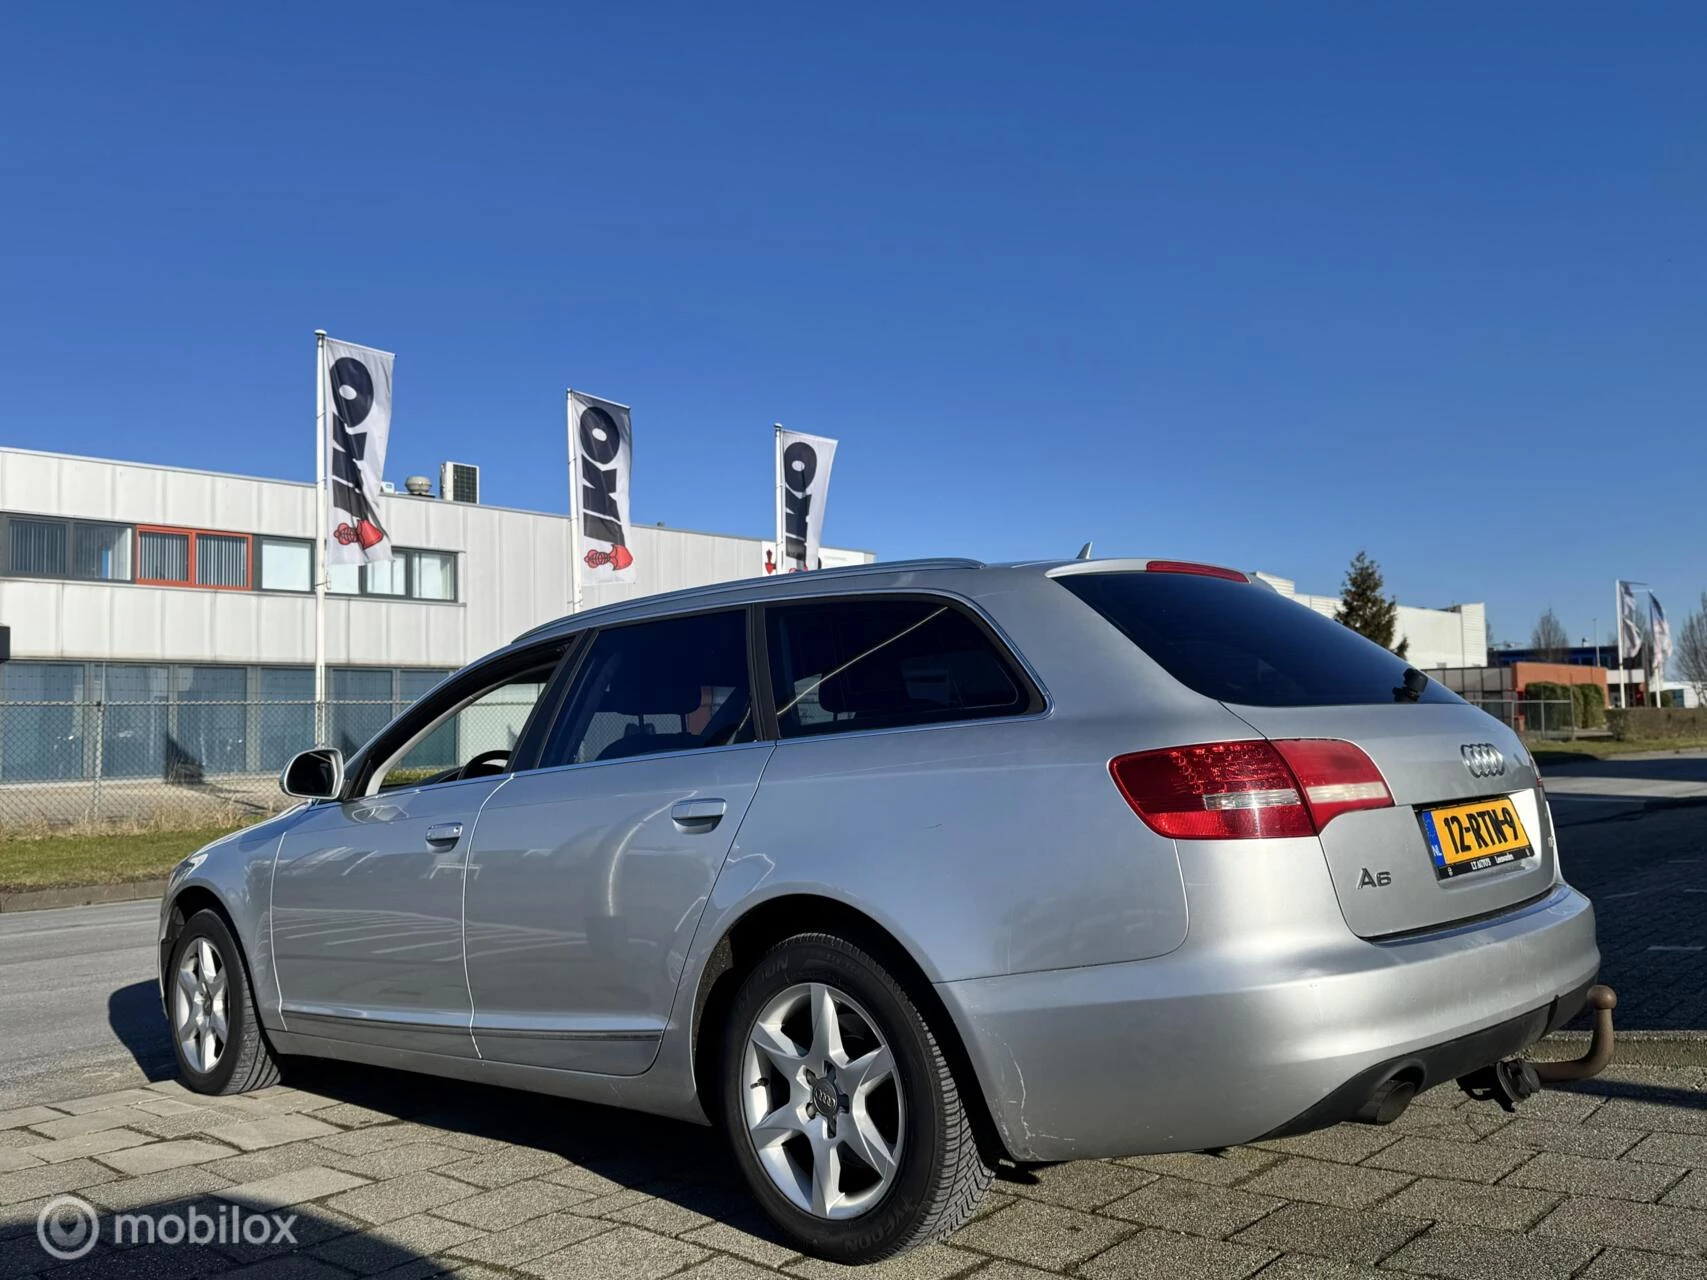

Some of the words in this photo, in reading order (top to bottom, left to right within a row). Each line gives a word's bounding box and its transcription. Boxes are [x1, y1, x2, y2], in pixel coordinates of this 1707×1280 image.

[330, 357, 375, 520] IKO
[580, 406, 626, 546] IKO
[784, 442, 817, 562] IKO
[1357, 867, 1392, 890] A6
[1432, 845, 1442, 857] NL
[1443, 807, 1519, 855] 12-RTN-9
